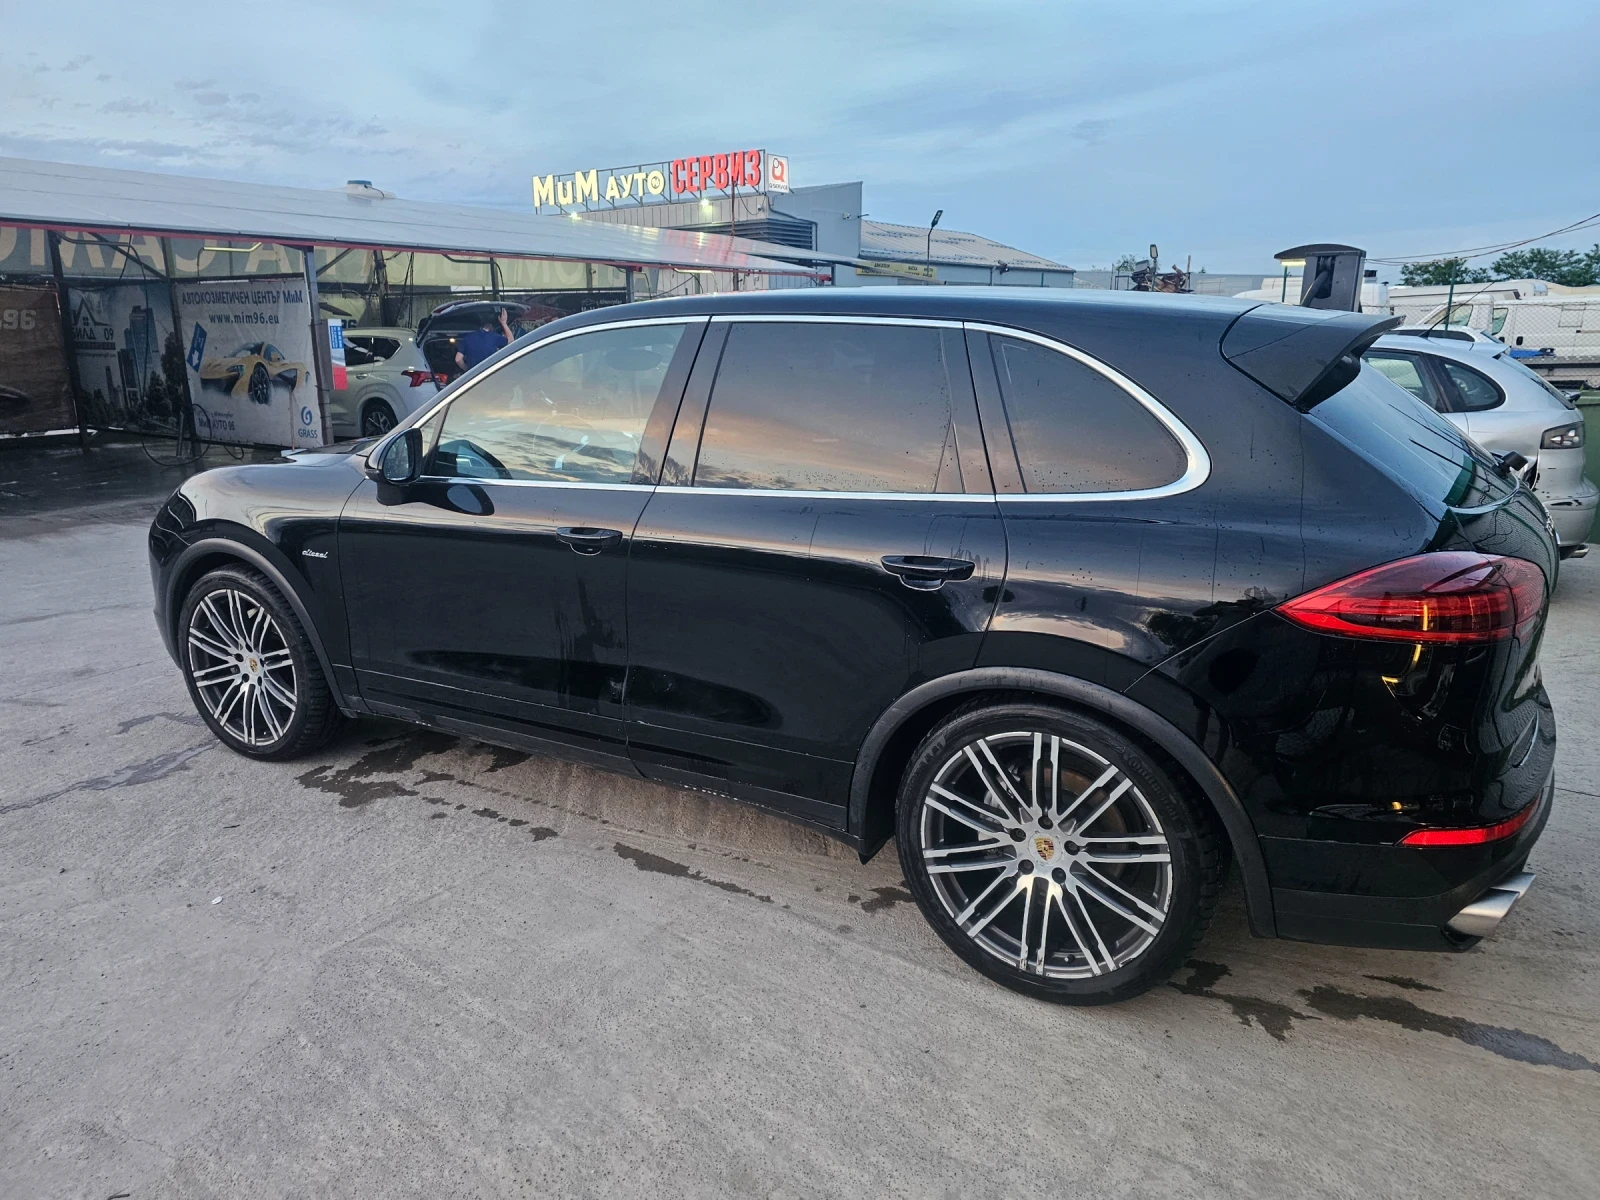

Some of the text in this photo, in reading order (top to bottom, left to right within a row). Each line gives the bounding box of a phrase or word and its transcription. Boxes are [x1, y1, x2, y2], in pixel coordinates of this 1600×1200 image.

[605, 170, 665, 201] АУТО
[671, 149, 762, 194] СЕРВИЗ
[182, 290, 250, 305] АВТОКОЗМЕТИЧЕН
[251, 290, 280, 306] ЦЕНТЪР
[0, 309, 37, 330] 96
[209, 312, 280, 325] www.mim96.eu
[104, 327, 114, 341] 09
[298, 428, 318, 439] GRASS
[301, 548, 329, 559] diesel
